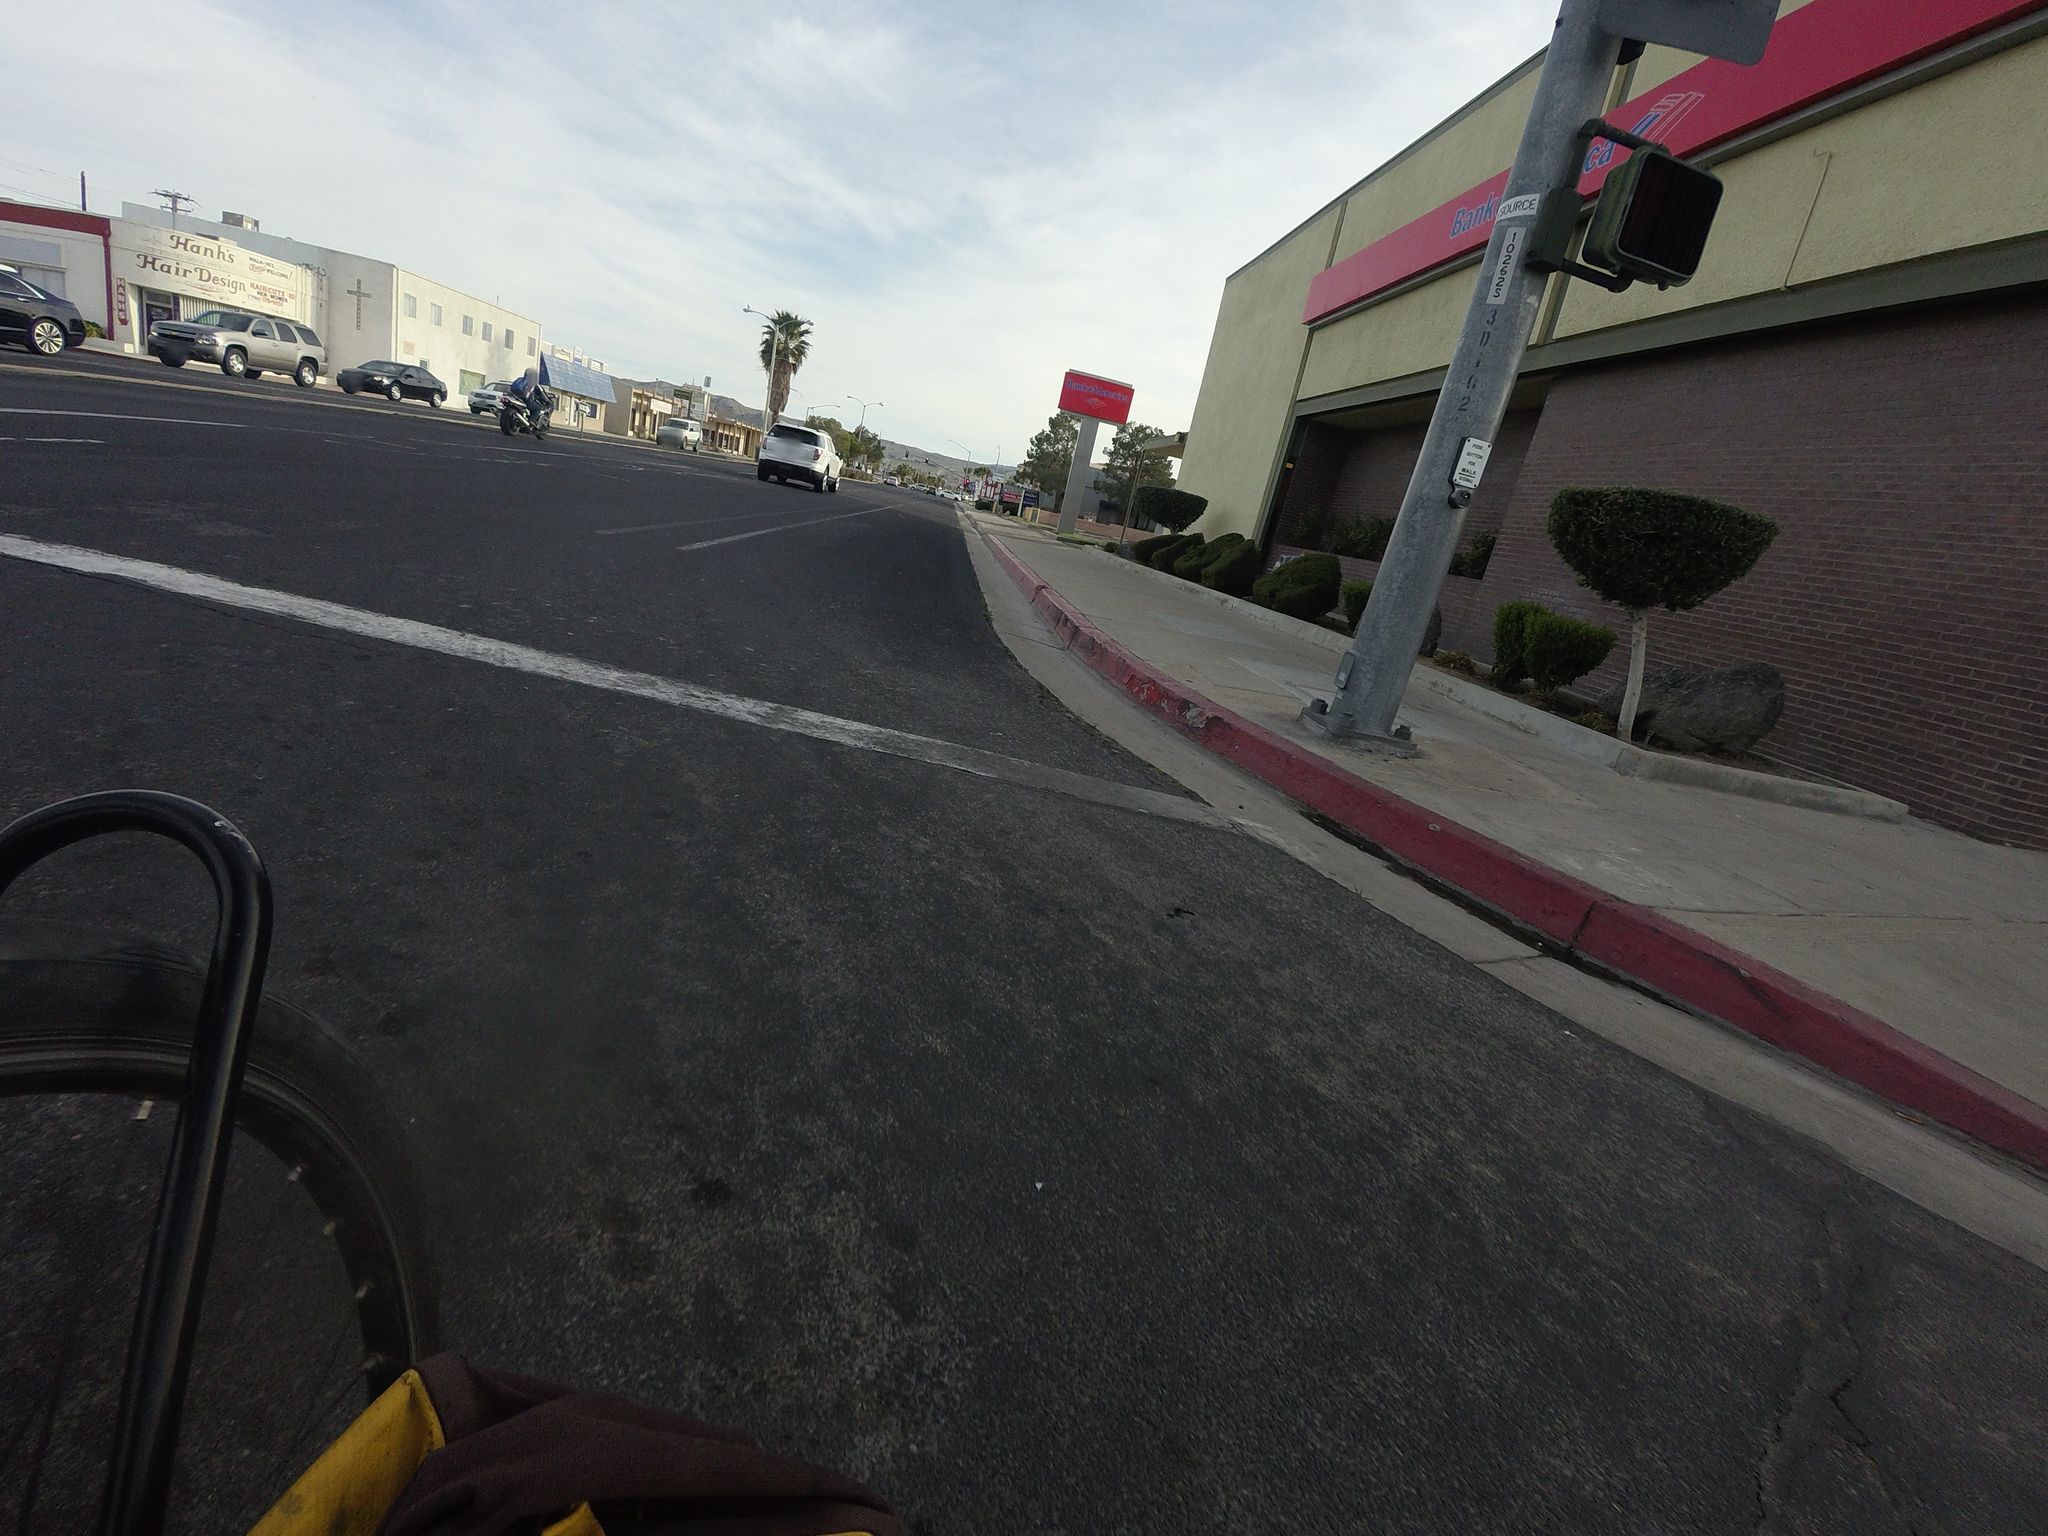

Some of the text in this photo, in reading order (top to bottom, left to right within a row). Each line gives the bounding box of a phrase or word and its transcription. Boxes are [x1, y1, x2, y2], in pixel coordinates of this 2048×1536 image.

[1449, 191, 1496, 239] Bank
[1500, 199, 1537, 217] SOURCE
[169, 235, 235, 263] Hanh's
[136, 253, 247, 294] Hair Design
